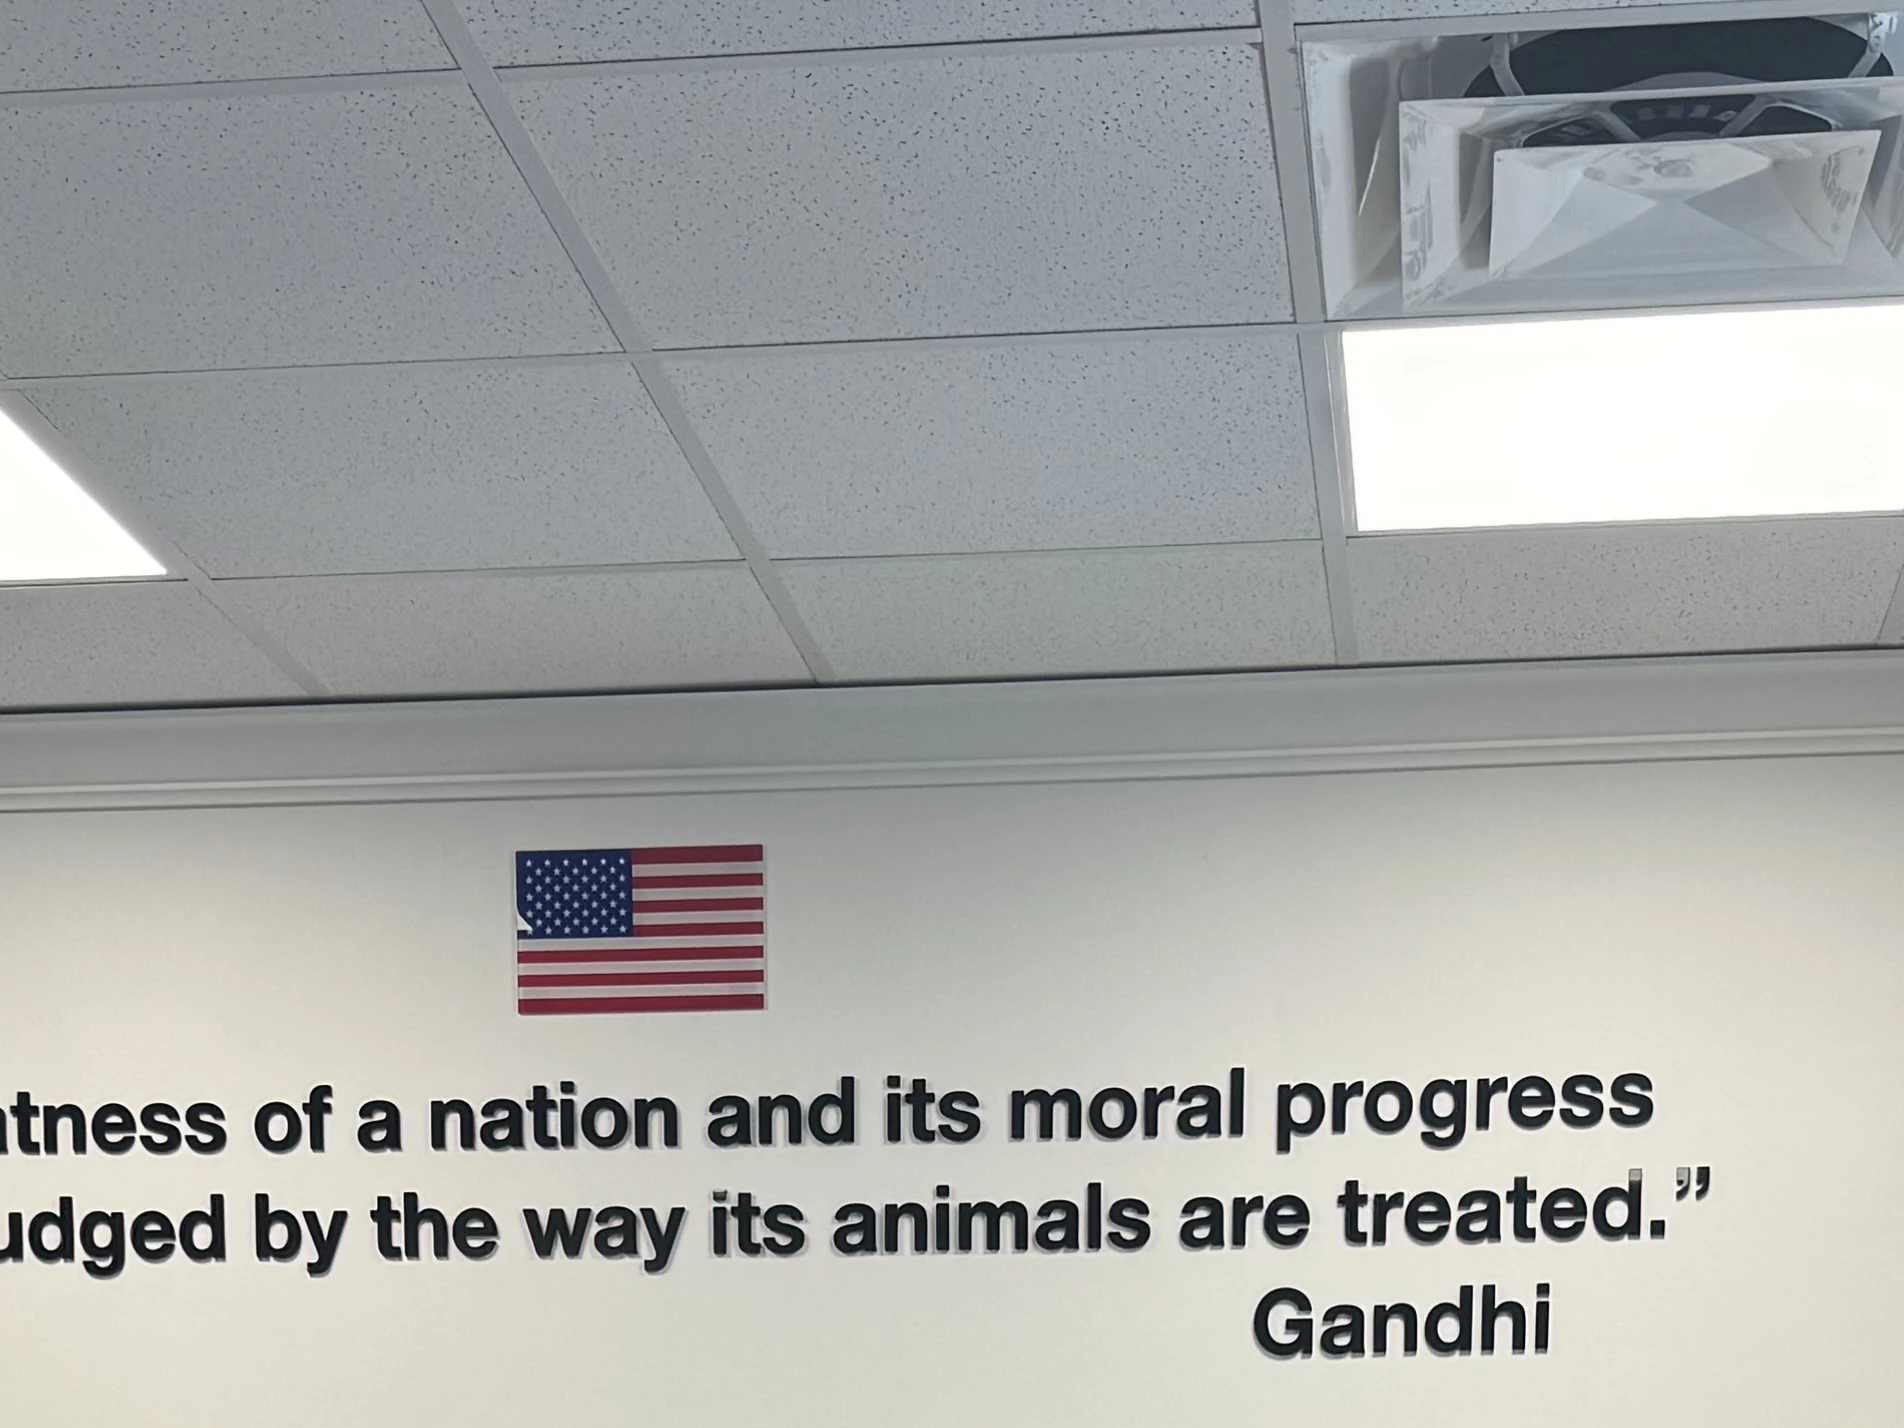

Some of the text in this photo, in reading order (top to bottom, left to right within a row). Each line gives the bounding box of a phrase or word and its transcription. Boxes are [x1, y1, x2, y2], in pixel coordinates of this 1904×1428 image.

[254, 1084, 333, 1153] of
[357, 1099, 402, 1152] a
[430, 1081, 679, 1150] nation
[707, 1076, 855, 1147] and
[886, 1075, 981, 1144] its
[1011, 1067, 1245, 1141] moral
[1277, 1071, 1654, 1153] progress
[255, 1193, 348, 1277] by
[370, 1190, 499, 1260] the
[522, 1204, 686, 1274] way
[712, 1189, 806, 1257] its
[833, 1182, 1151, 1254] animals
[1179, 1194, 1310, 1249] are
[1337, 1167, 1710, 1244] treated.”
[1253, 1284, 1550, 1357] Gandhi
